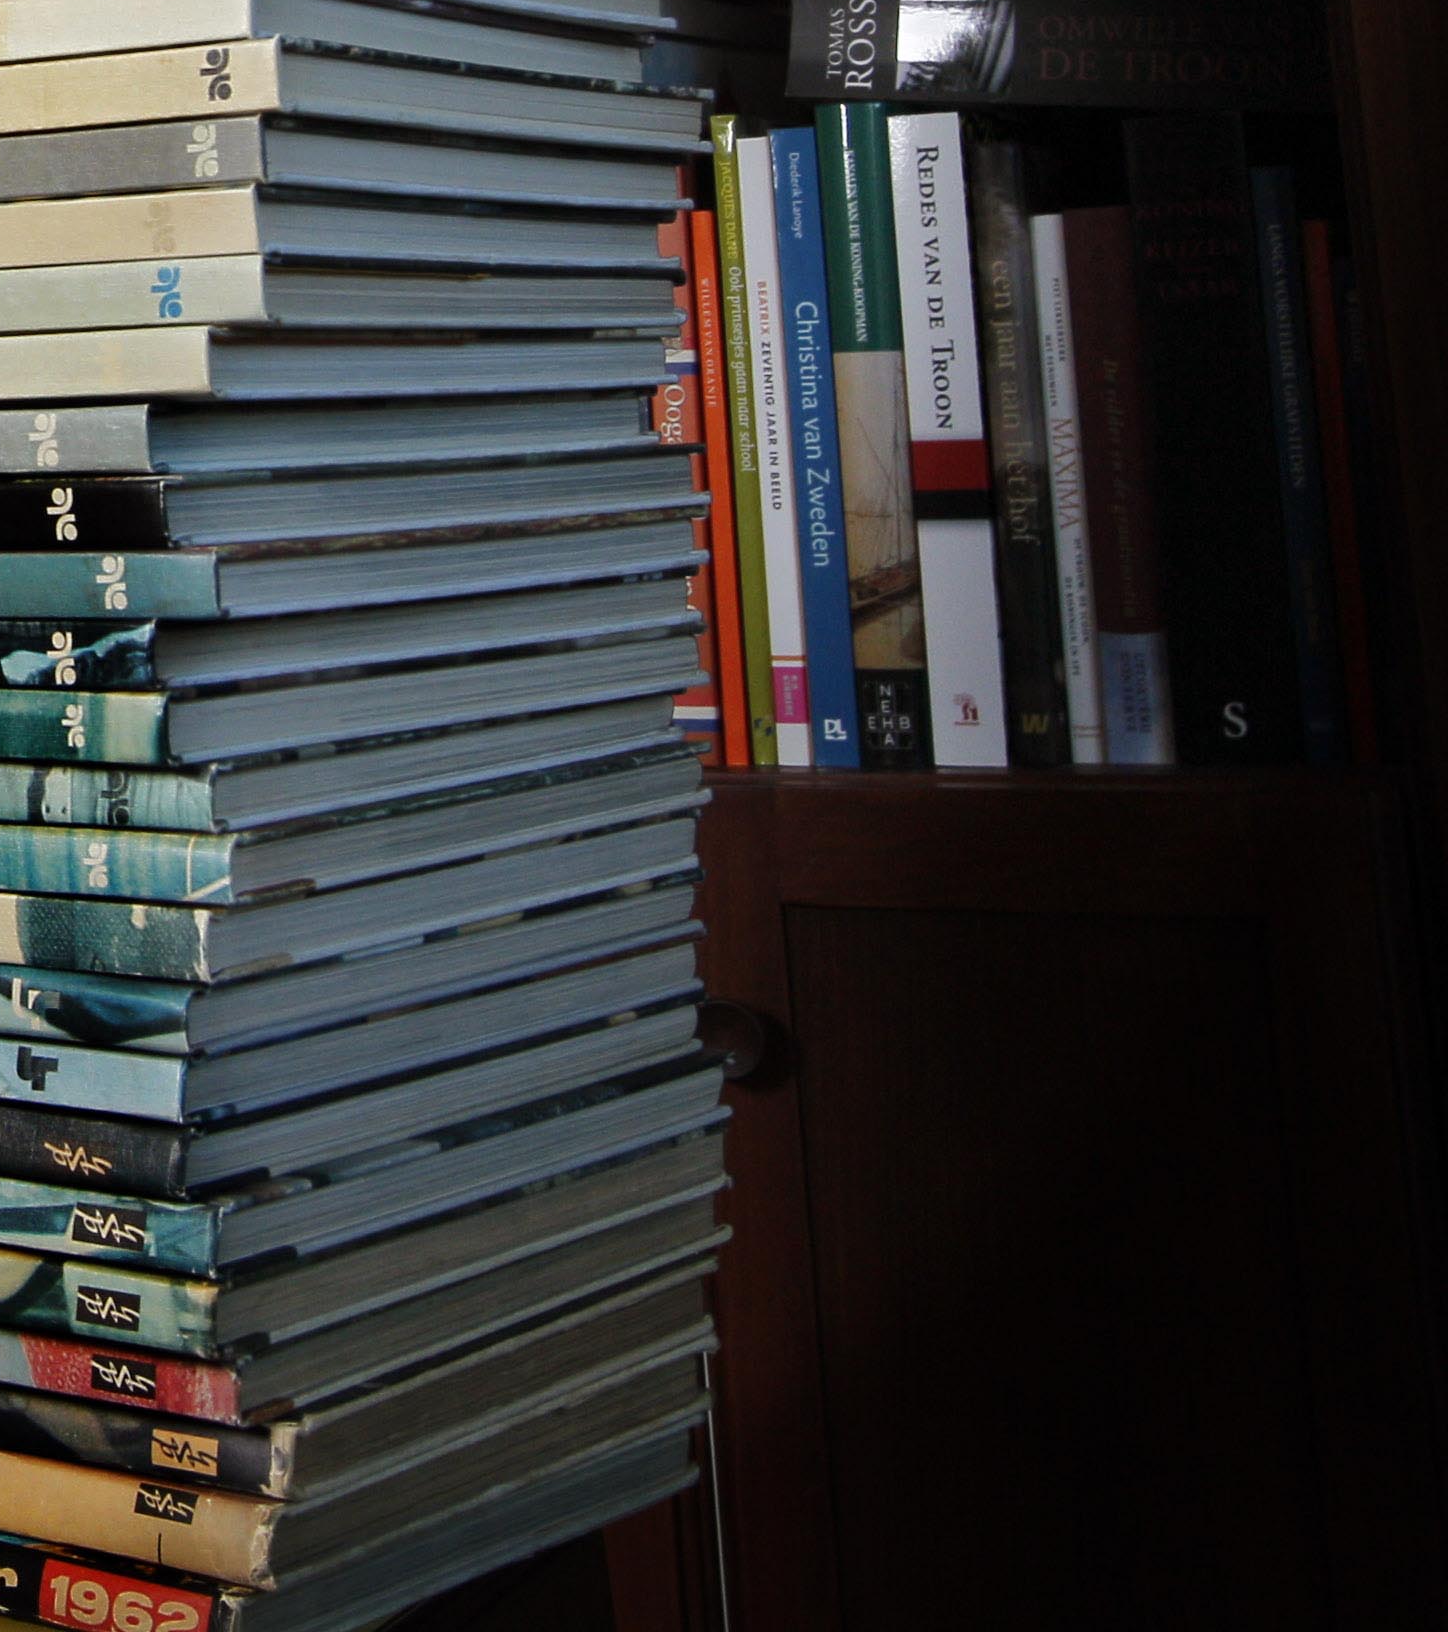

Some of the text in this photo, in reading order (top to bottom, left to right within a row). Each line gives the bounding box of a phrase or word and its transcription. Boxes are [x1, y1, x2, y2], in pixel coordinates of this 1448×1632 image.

[826, 8, 845, 79] TOMAS
[917, 145, 954, 430] REDES VAN DE TROON
[756, 280, 782, 511] BEATRIX ZEVENTIG JAAR IN BEELD
[795, 300, 835, 567] Christina van Zweden
[1222, 701, 1248, 738] S
[50, 1575, 199, 1632] 1962
